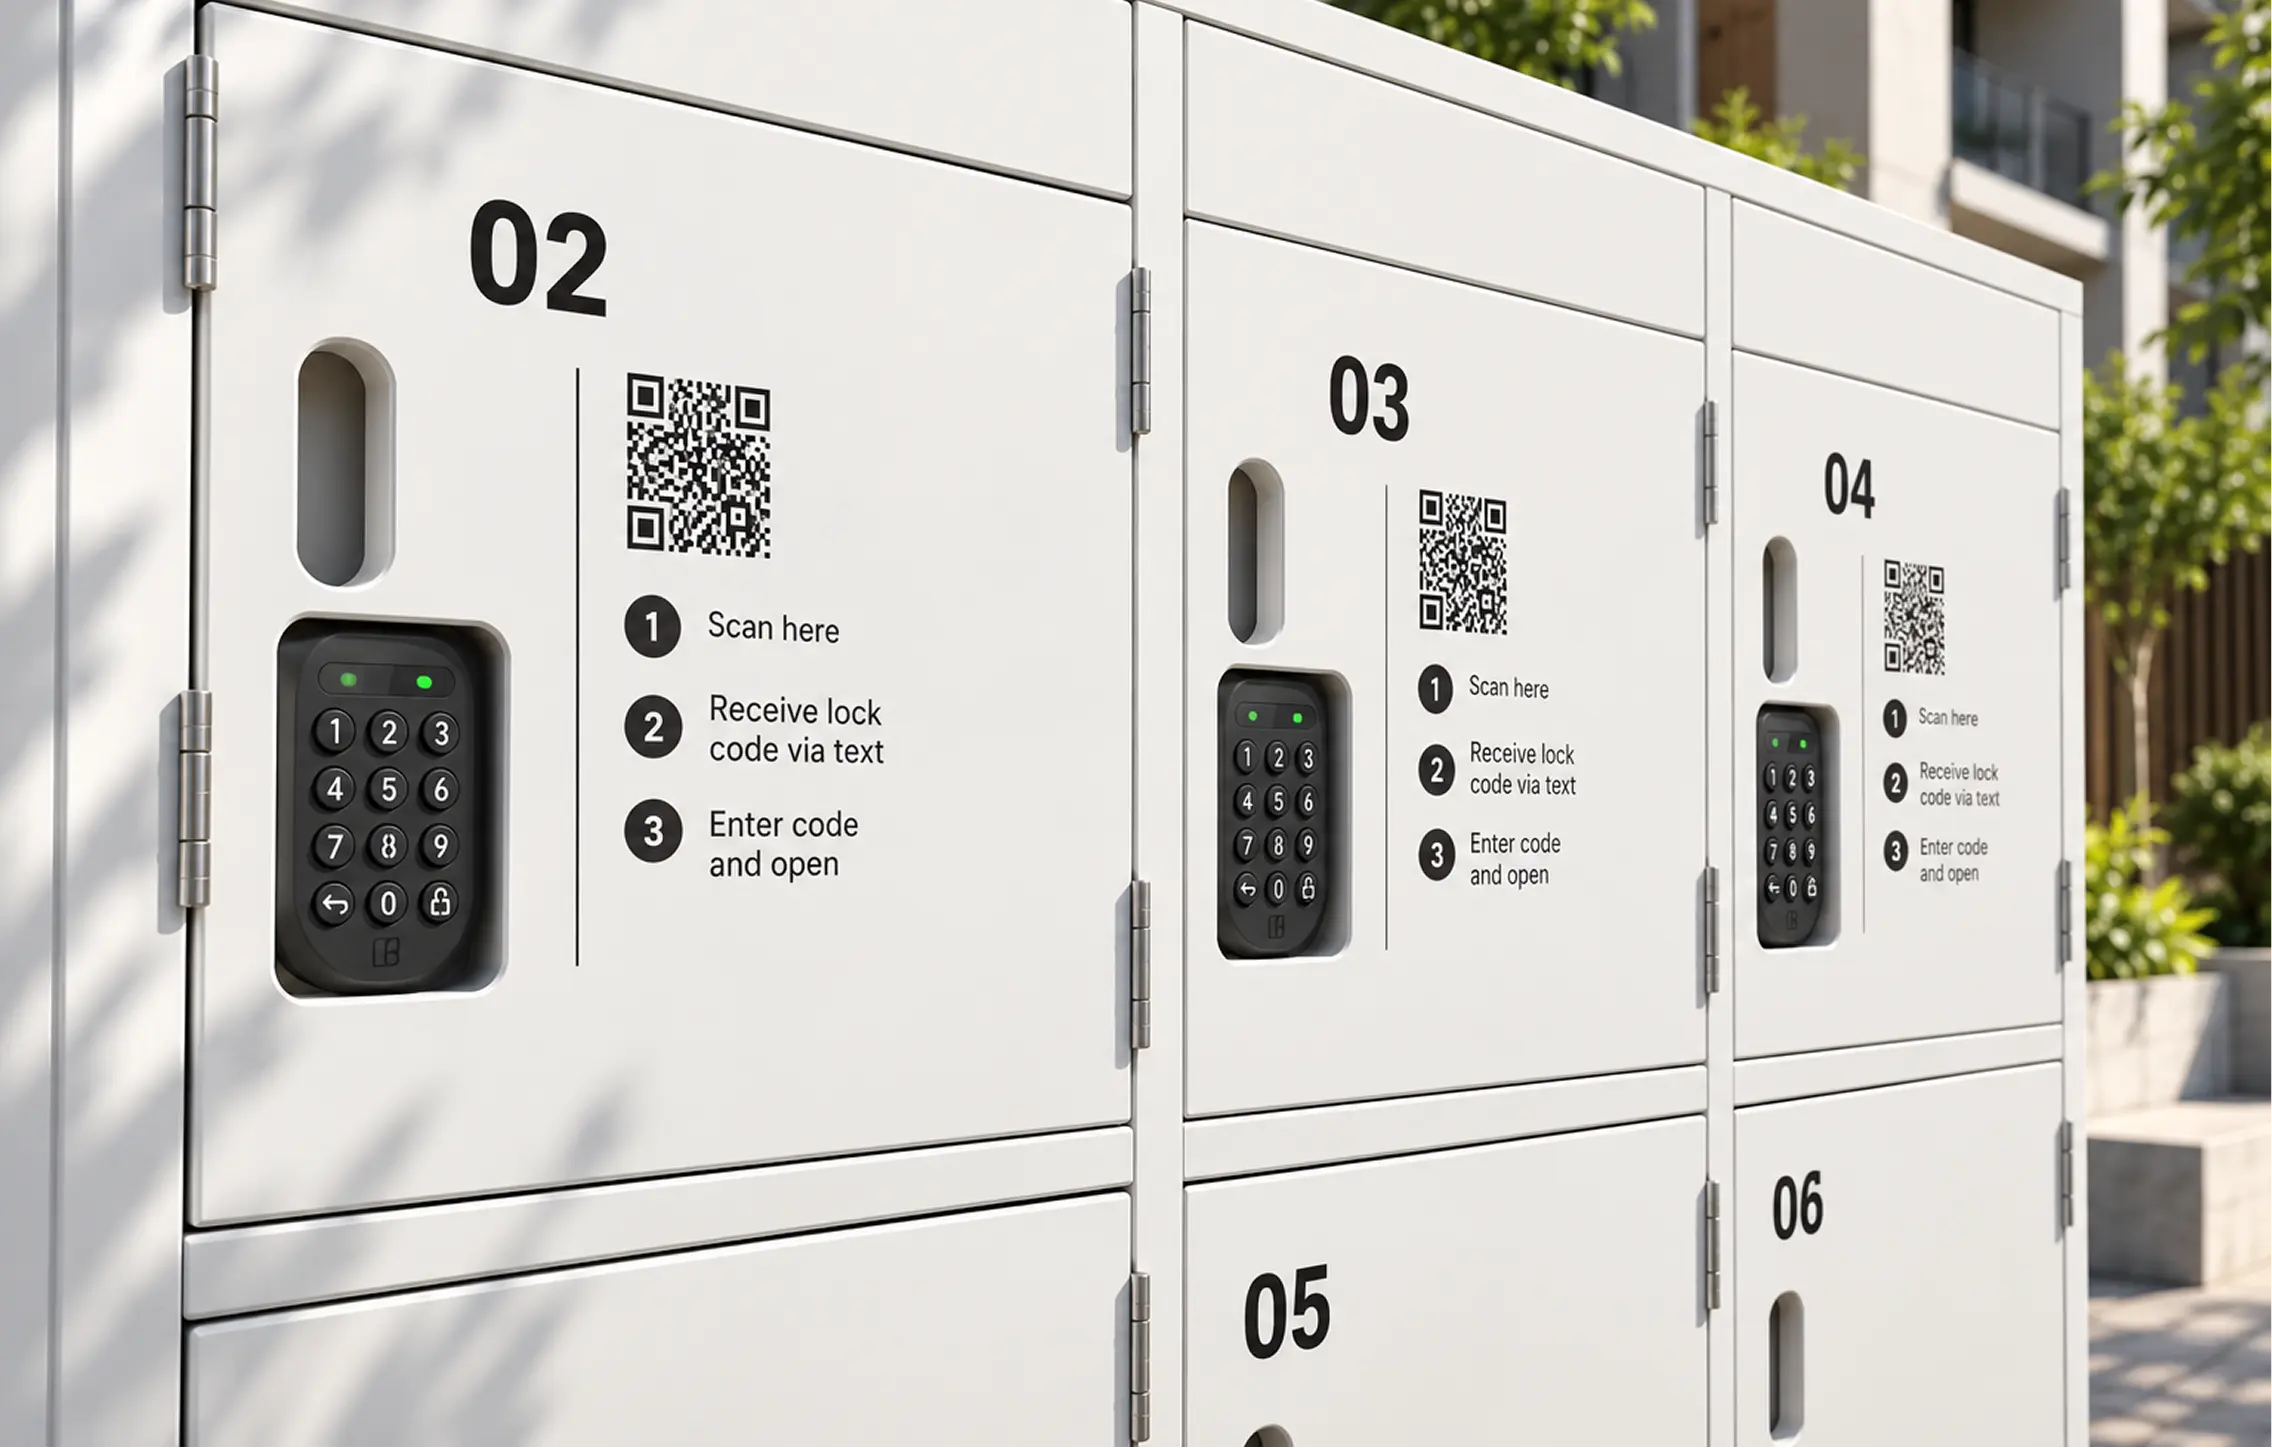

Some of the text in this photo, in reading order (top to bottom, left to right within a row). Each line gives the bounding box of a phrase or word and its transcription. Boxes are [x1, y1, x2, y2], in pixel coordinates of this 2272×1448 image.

[471, 200, 606, 317] 02
[1330, 355, 1409, 441] 03
[1825, 452, 1875, 519] 04
[646, 611, 839, 643] 1 Scan here
[1430, 675, 1548, 702] 1 Scan here
[711, 695, 881, 725] Receive lock
[1891, 707, 1978, 729] 1 Scan here
[330, 717, 448, 745] 1 2 3
[645, 712, 663, 741] 2
[711, 735, 883, 763] code via text
[1244, 746, 1314, 769] 1 2 3
[1471, 741, 1574, 764] Receive lock
[1431, 757, 1443, 782] 2
[1770, 768, 1815, 787] 1 2 3
[1920, 762, 1998, 781] Receive lock
[327, 777, 448, 801] 4 5 6
[1471, 773, 1576, 795] code via text
[1891, 772, 1901, 794] 2
[1242, 791, 1314, 812] 4 5 6
[1920, 789, 1999, 806] code via text
[711, 810, 858, 837] Enter code
[1769, 806, 1816, 824] 4 5 6
[645, 816, 663, 846] 3
[1471, 832, 1560, 853] Enter code
[328, 834, 448, 859] 7 8 9
[1242, 835, 1313, 856] 7 8 9
[1432, 843, 1443, 867] 3
[1770, 842, 1816, 861] 7 8 9
[1891, 840, 1901, 862] 3
[1921, 838, 1988, 855] Enter code
[711, 850, 838, 883] and open
[1471, 864, 1548, 889] and open
[1920, 864, 1979, 885] and open
[1274, 878, 1284, 900] 0
[1789, 879, 1798, 897] 0
[382, 891, 396, 915] 0
[1774, 1171, 1823, 1240] 06
[1245, 1264, 1330, 1359] 05
